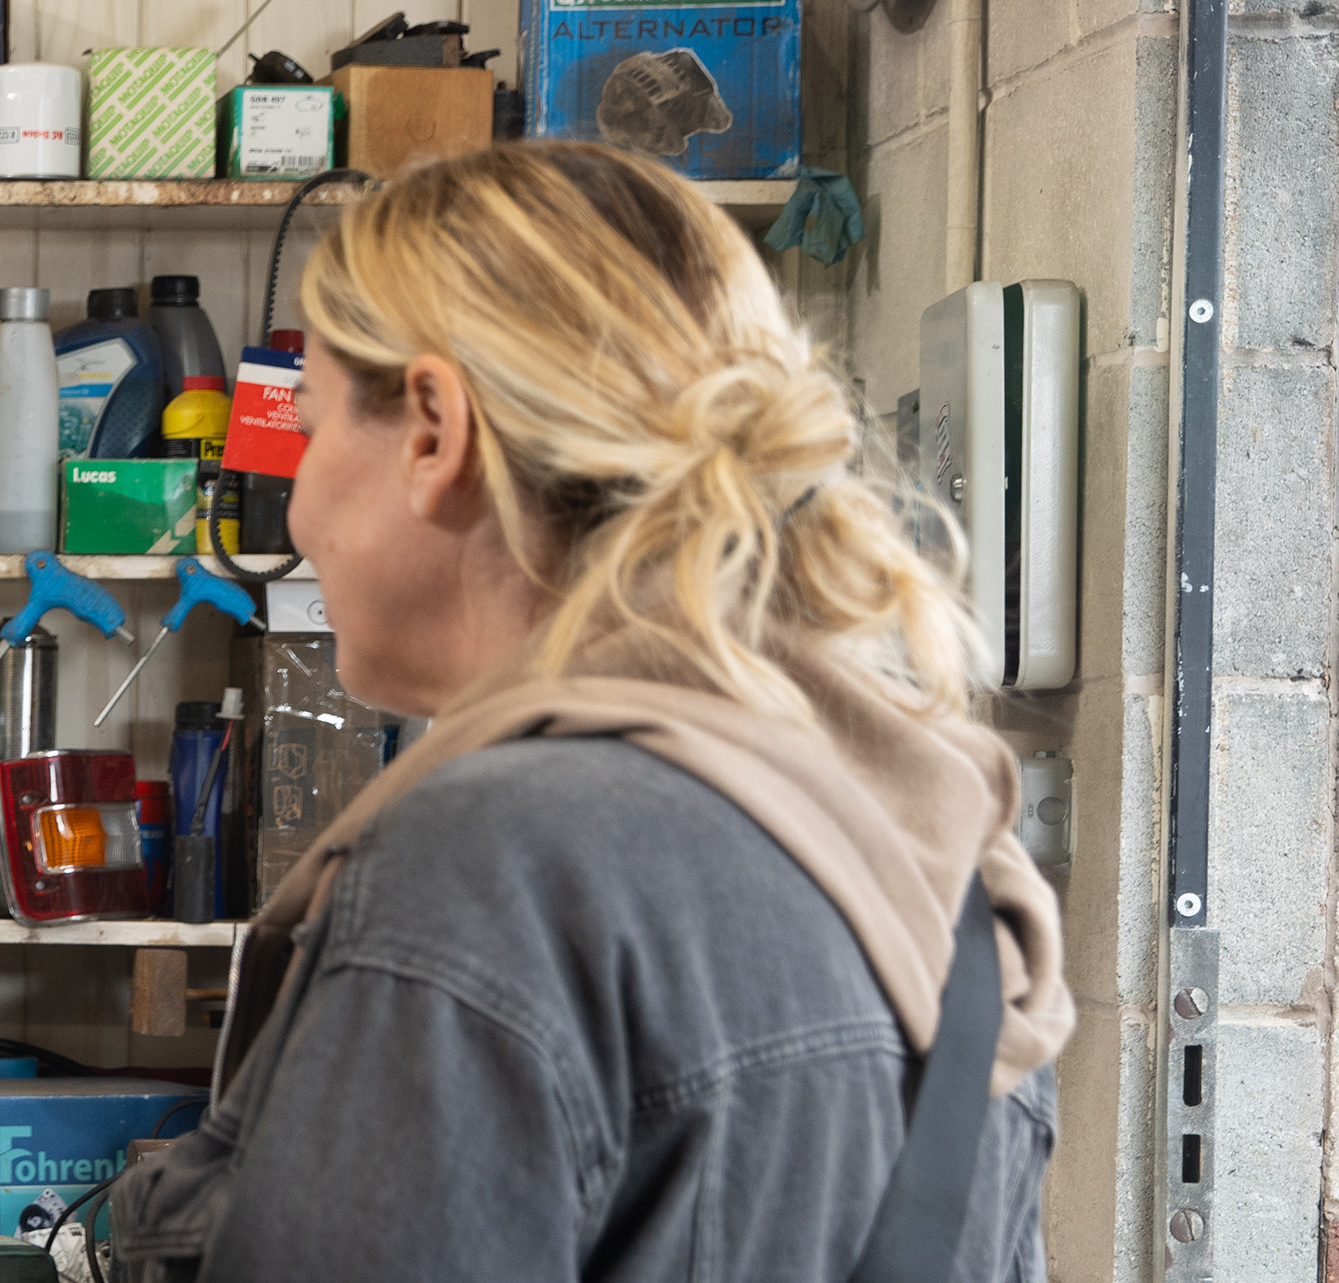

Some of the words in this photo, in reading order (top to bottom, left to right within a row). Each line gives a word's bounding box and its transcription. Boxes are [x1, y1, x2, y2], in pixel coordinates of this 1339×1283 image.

[553, 17, 782, 40] ALTERNATOR
[118, 52, 168, 104] MOTAQUIP
[108, 94, 160, 147] MOTAQUIP
[152, 86, 202, 138] MOTAQUIP
[263, 386, 292, 403] FAN
[267, 409, 300, 422] VENTILA
[72, 466, 117, 484] Lucas
